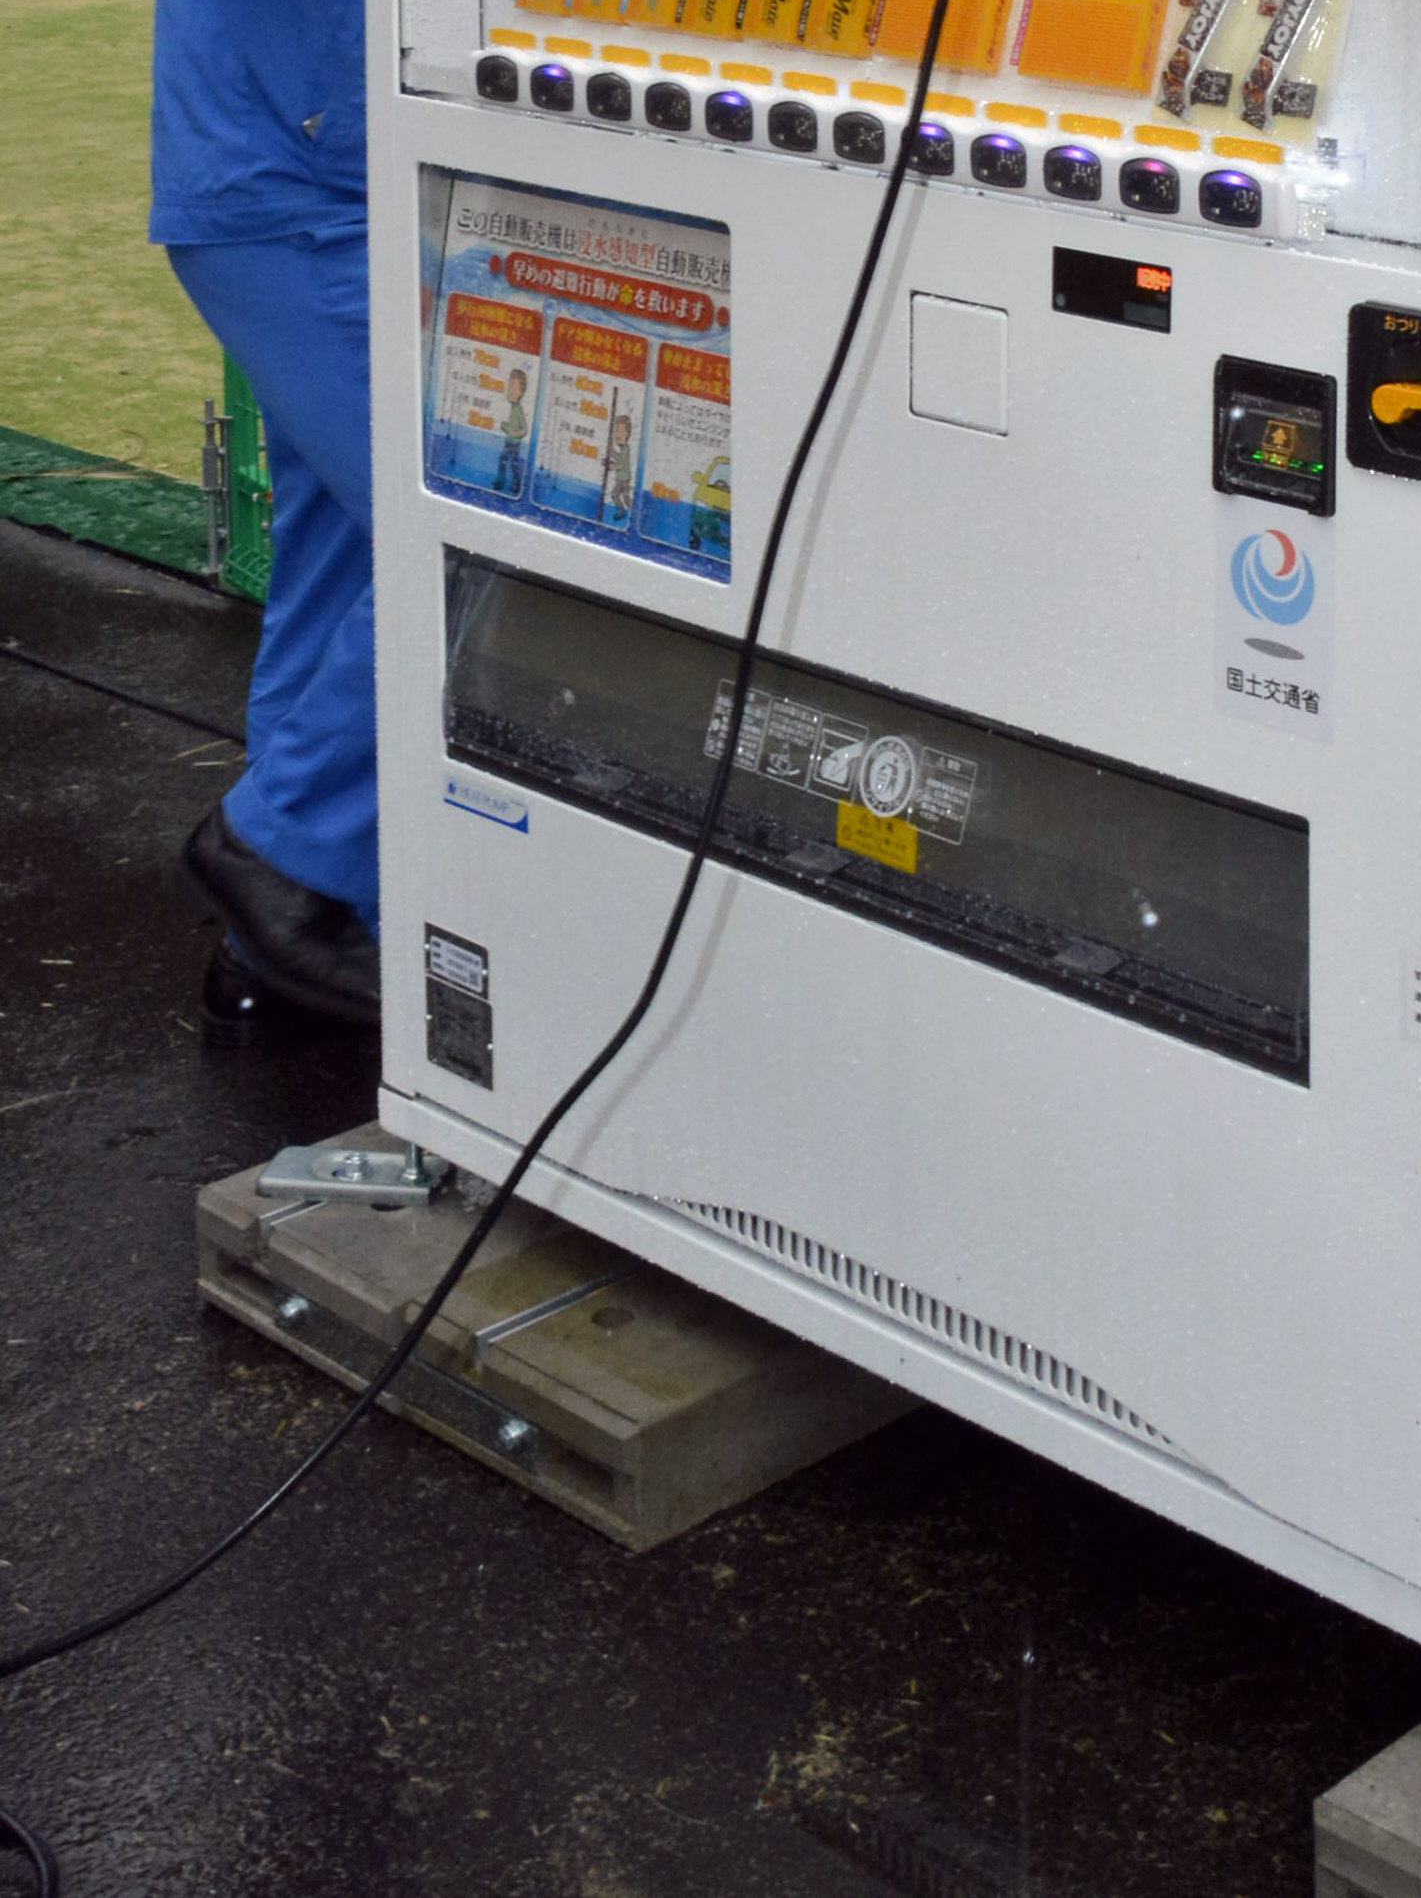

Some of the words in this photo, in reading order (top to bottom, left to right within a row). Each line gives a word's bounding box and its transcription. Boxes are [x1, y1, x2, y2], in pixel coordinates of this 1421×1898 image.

[513, 259, 706, 322] 早めの避難行動が命を救います
[1226, 666, 1320, 715] 国土交通省
